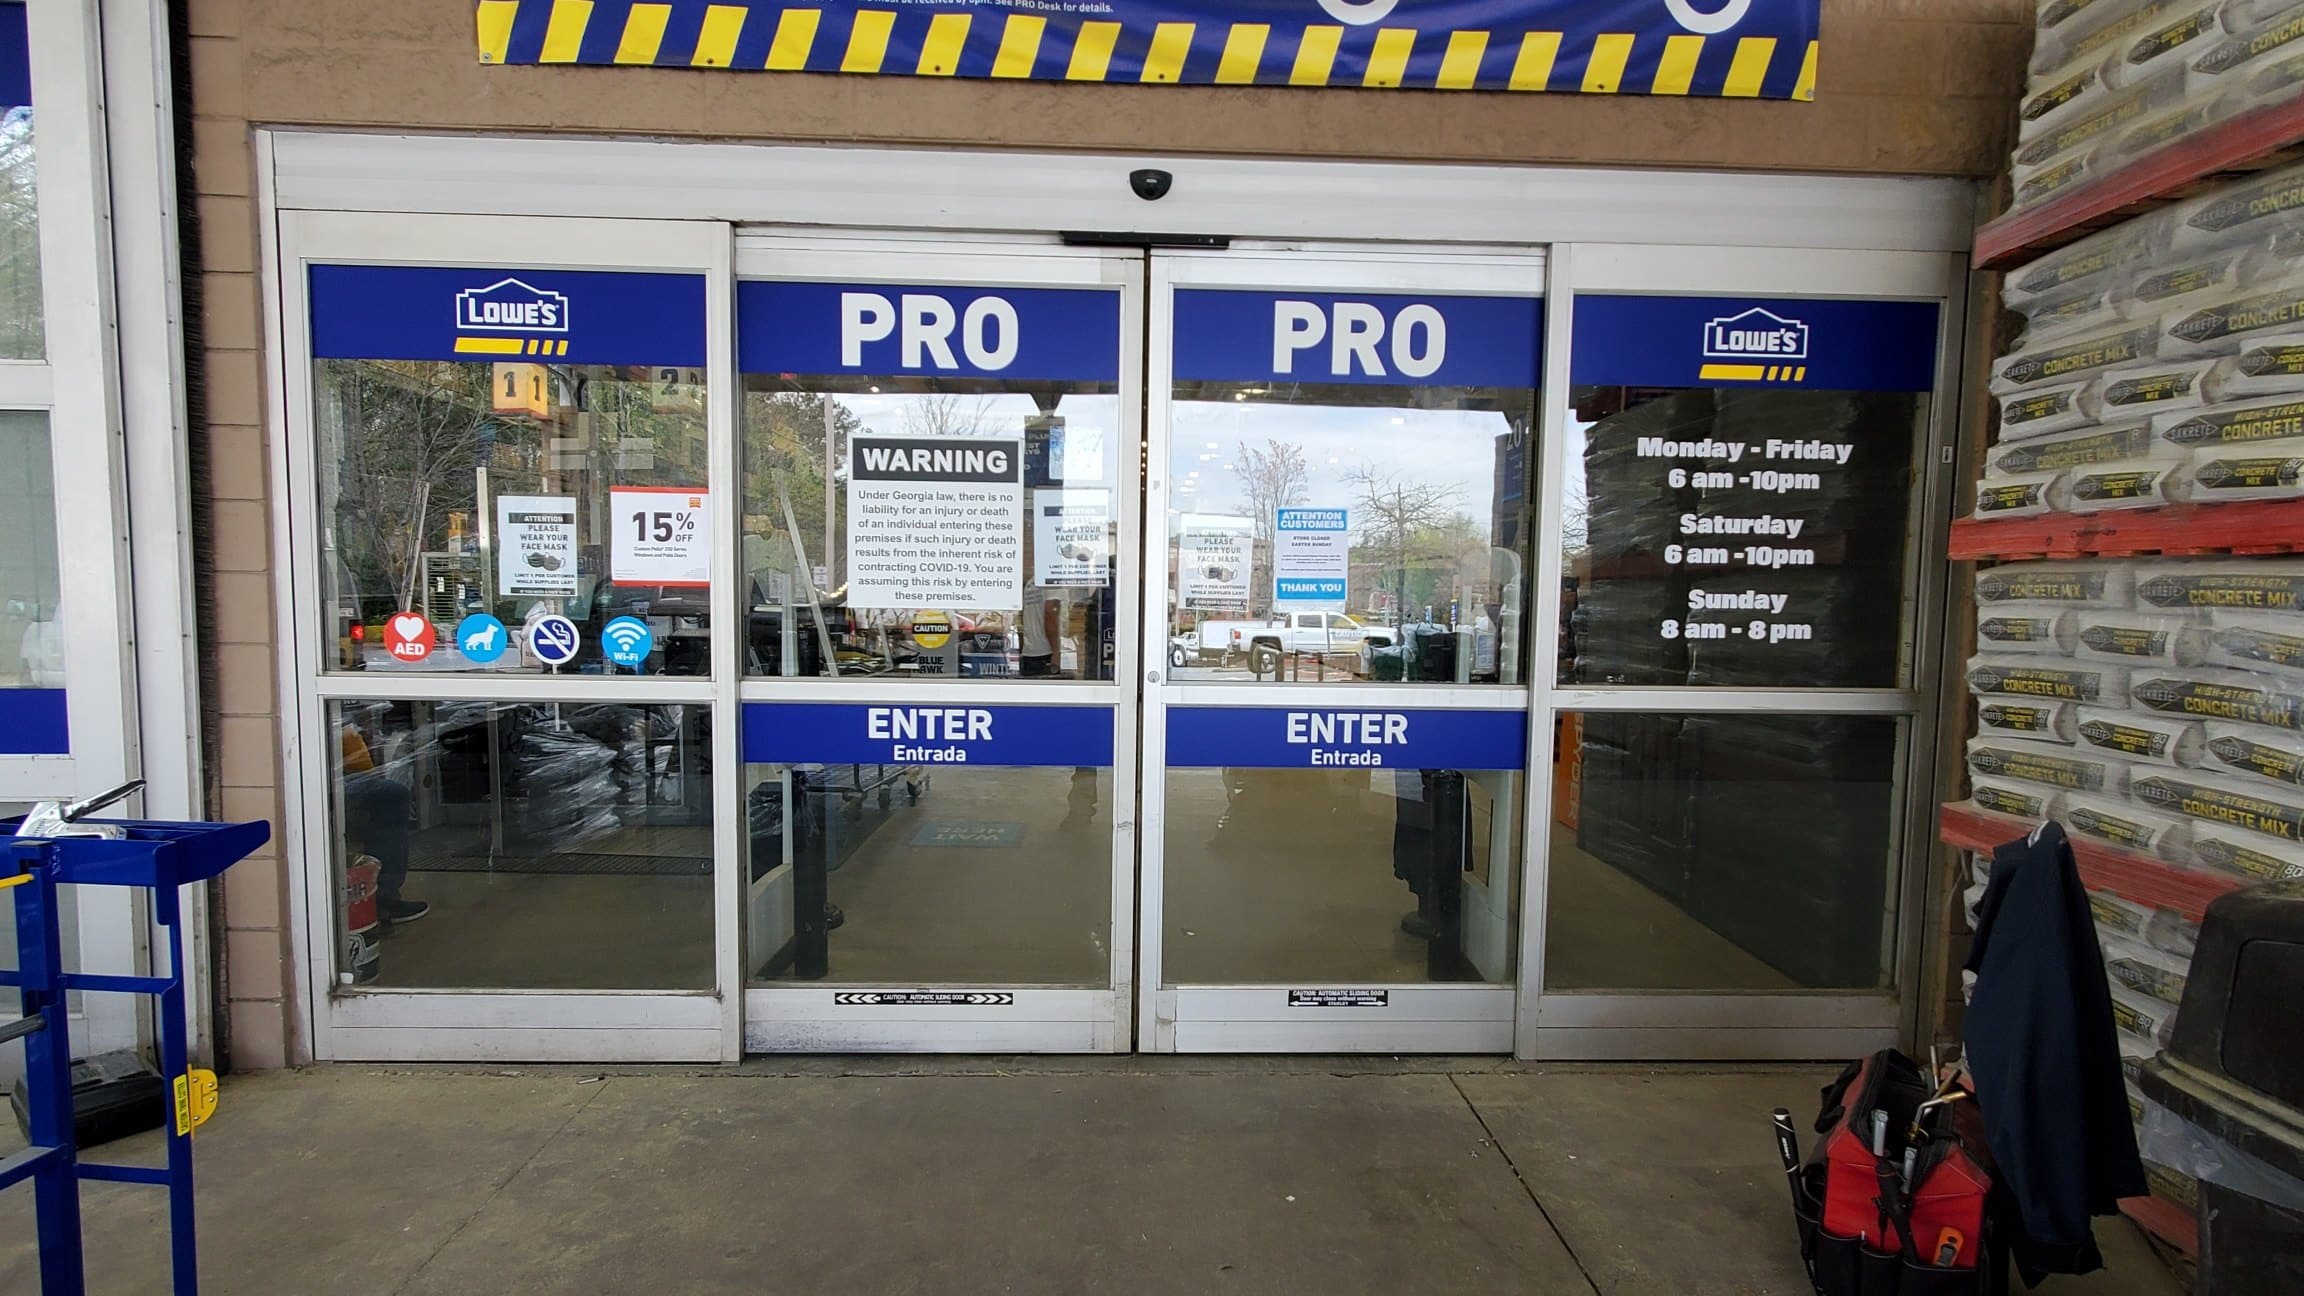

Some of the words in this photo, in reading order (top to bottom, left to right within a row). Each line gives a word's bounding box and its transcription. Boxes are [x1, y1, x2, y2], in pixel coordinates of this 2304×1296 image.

[1015, 0, 1035, 9] PRO
[1038, 1, 1062, 11] Desk
[1063, 2, 1077, 12] for
[1079, 2, 1114, 13] details.
[468, 297, 559, 325] LOWE'S
[841, 292, 1019, 370] PRO
[1273, 300, 1447, 378] PRO
[1715, 326, 1798, 353] LOWE'S
[2043, 349, 2103, 375] CONCRETE
[2105, 343, 2130, 361] MIX
[2222, 417, 2303, 441] CONCRETE
[1636, 438, 1747, 463] Monday
[1765, 439, 1855, 464] Friday
[2036, 450, 2096, 469] CONCRETE
[863, 448, 1008, 473] WARNING
[1668, 468, 1687, 488] 6
[1691, 471, 1734, 488] am
[858, 490, 890, 500] Under
[892, 490, 934, 502] Georgia
[936, 490, 957, 502] law,
[959, 491, 985, 501] there
[988, 491, 996, 501] is
[1001, 494, 1013, 502] no
[862, 504, 899, 516] liability
[902, 505, 916, 515] for
[919, 507, 932, 515] an
[934, 505, 964, 517] injury
[966, 508, 979, 516] or
[980, 506, 1009, 516] death
[1282, 511, 1342, 520] ATTENTION
[858, 519, 869, 528] of
[871, 521, 884, 529] an
[886, 519, 937, 529] individual
[939, 520, 982, 532] entering
[985, 520, 1013, 531] these
[1280, 519, 1345, 529] CUSTOMERS
[1680, 513, 1805, 539] Saturday
[521, 543, 543, 551] FACE
[544, 543, 568, 551] MASK
[676, 534, 695, 543] OFF
[855, 533, 902, 545] premises
[905, 533, 913, 543] if
[913, 534, 940, 544] such
[942, 534, 972, 546] injury
[974, 536, 986, 545] or
[987, 535, 1017, 545] death
[855, 547, 890, 558] results
[893, 548, 918, 558] from
[920, 548, 937, 558] the
[939, 549, 982, 559] inherent
[984, 549, 1003, 559] risk
[1005, 549, 1017, 560] of
[1664, 544, 1683, 565] 6
[1685, 547, 1729, 565] am
[858, 562, 917, 574] contracting
[919, 562, 973, 573] COVID-19.
[974, 563, 994, 573] You
[996, 565, 1013, 573] are
[858, 576, 909, 588] assuming
[911, 577, 930, 586] this
[933, 577, 953, 587] risk
[955, 577, 968, 588] by
[970, 578, 1013, 590] entering
[1280, 583, 1318, 592] THANK
[1319, 583, 1342, 592] YOU
[895, 591, 923, 600] these
[926, 592, 977, 602] premises.
[1688, 589, 1789, 614] Sunday
[2188, 589, 2262, 606] CONCRETE
[2267, 590, 2299, 607] MIX
[914, 625, 949, 633] CAUTION
[1660, 619, 1680, 639] 8
[1684, 622, 1727, 639] am
[1748, 620, 1767, 640] 8
[1770, 624, 1813, 644] pm
[394, 642, 425, 656] AED
[613, 652, 639, 662] Wi-Fi
[918, 656, 945, 665] BLUE
[2003, 678, 2054, 695] CONCRETE
[2055, 681, 2076, 697] MIX
[2184, 697, 2257, 721] CONCRETE
[2260, 710, 2292, 728] MIX
[868, 708, 993, 741] ENTER
[1287, 712, 1409, 744] ENTER
[2152, 733, 2168, 744] 80
[893, 744, 967, 762] Entrada
[1311, 748, 1383, 765] Entrada
[2003, 763, 2055, 783] CONCRETE
[2057, 770, 2078, 786] MIX
[2183, 799, 2256, 828] CONCRETE
[2260, 816, 2290, 837] MIX
